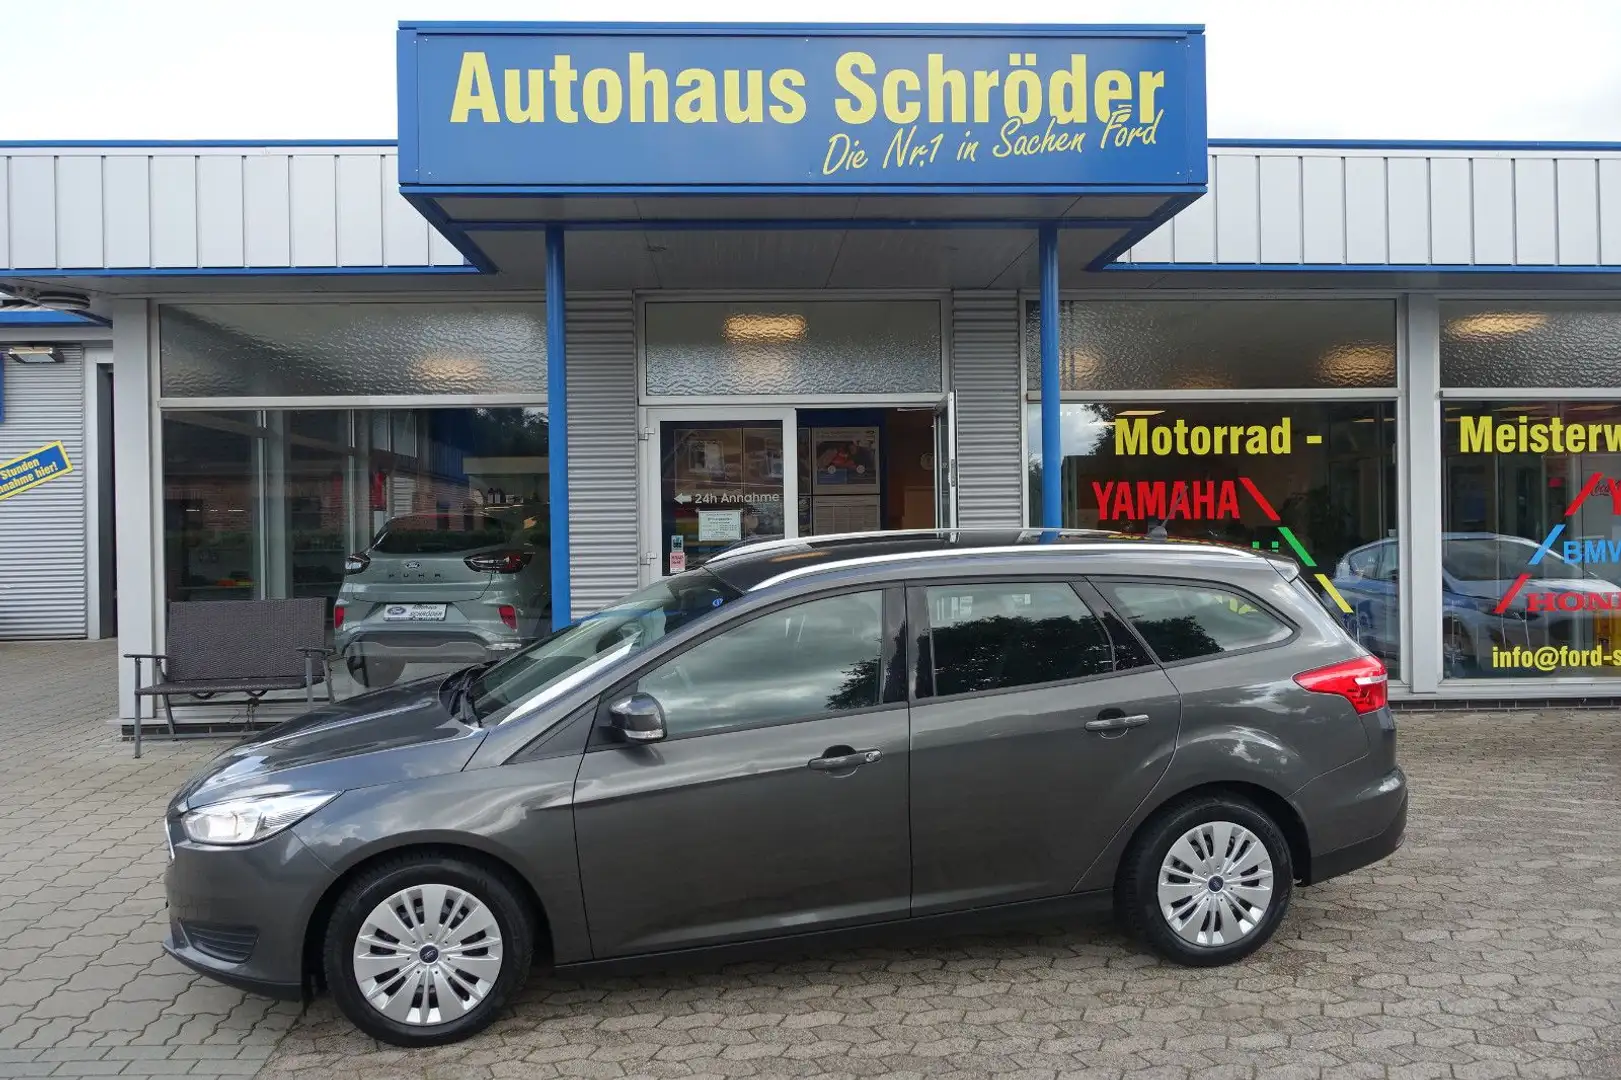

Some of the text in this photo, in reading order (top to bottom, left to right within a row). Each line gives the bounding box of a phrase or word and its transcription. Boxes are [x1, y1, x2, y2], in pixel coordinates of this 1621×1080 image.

[449, 51, 1166, 125] Autohaus Schröder
[822, 103, 1165, 176] Die Nr.1 in Sachen Ford
[1114, 416, 1292, 456] Motorrad
[0, 459, 40, 480] Stunden
[34, 461, 58, 478] hier!
[694, 492, 780, 504] 24h Annahme
[1092, 480, 1240, 520] YAMAHA
